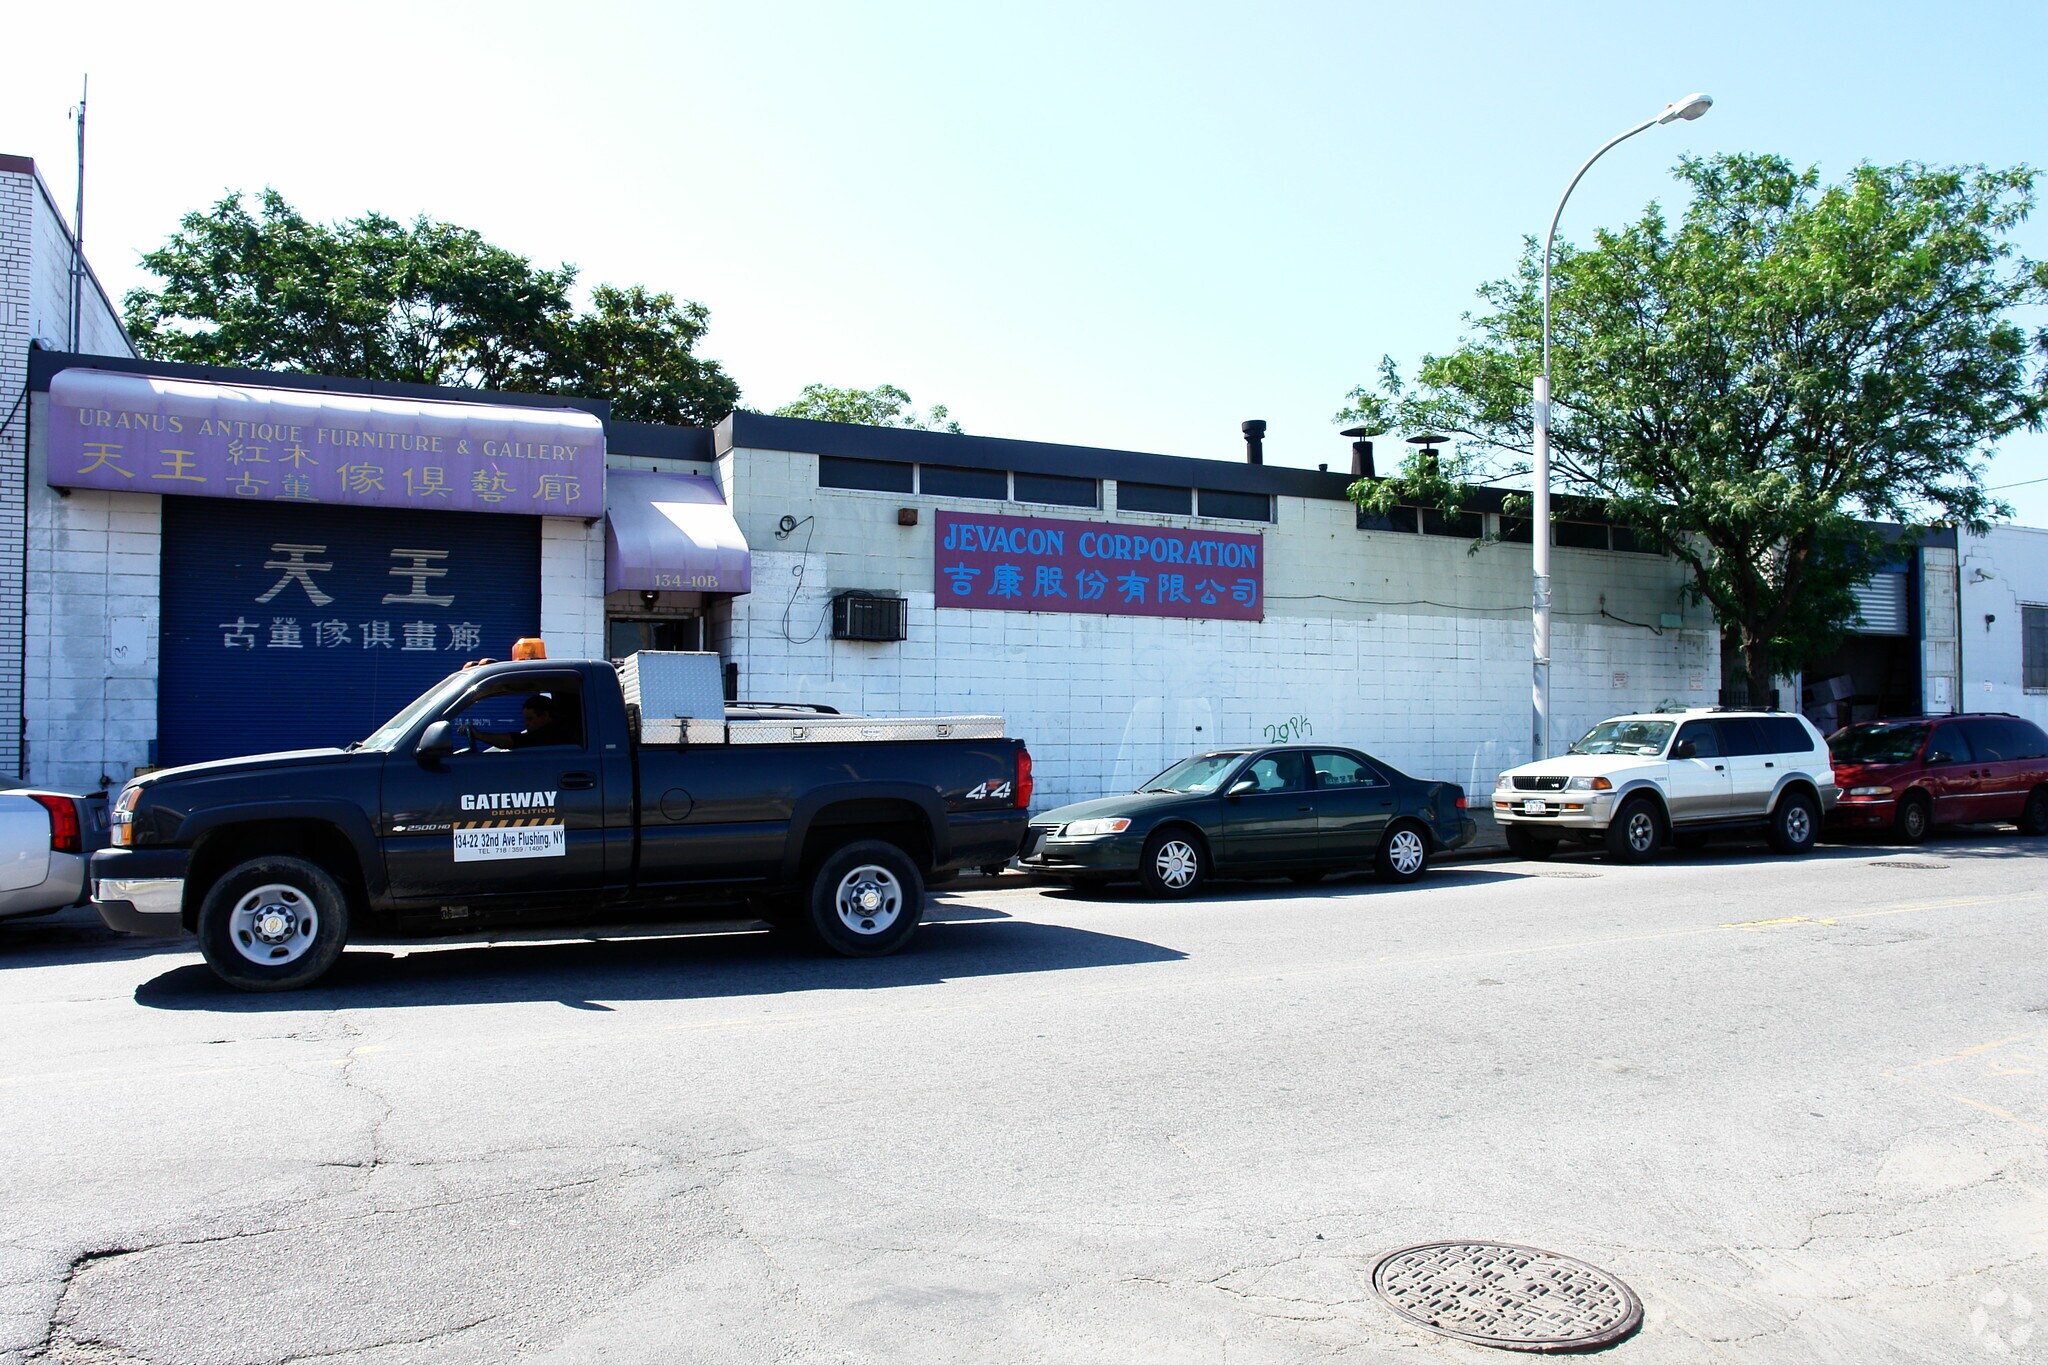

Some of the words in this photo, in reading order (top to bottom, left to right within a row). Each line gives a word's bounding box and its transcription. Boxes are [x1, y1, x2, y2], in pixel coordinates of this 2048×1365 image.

[78, 408, 183, 433] URANUS
[199, 419, 303, 443] ANTIQUE
[317, 427, 443, 453] FURNITURE
[457, 439, 471, 455] &
[483, 440, 578, 461] GALLERY
[76, 442, 207, 482] 天王
[943, 523, 1064, 556] JEVACON
[1079, 531, 1257, 569] CORPORATION
[254, 543, 456, 607] 天王
[655, 574, 719, 588] 134-10B
[943, 561, 1257, 608] 吉康股份有限公司
[460, 791, 558, 811] GATEWAY
[491, 808, 556, 816] DEMOLITION
[454, 834, 479, 848] 134-22
[481, 833, 499, 847] 32nd
[502, 832, 516, 846] Ave
[553, 831, 564, 844] NY
